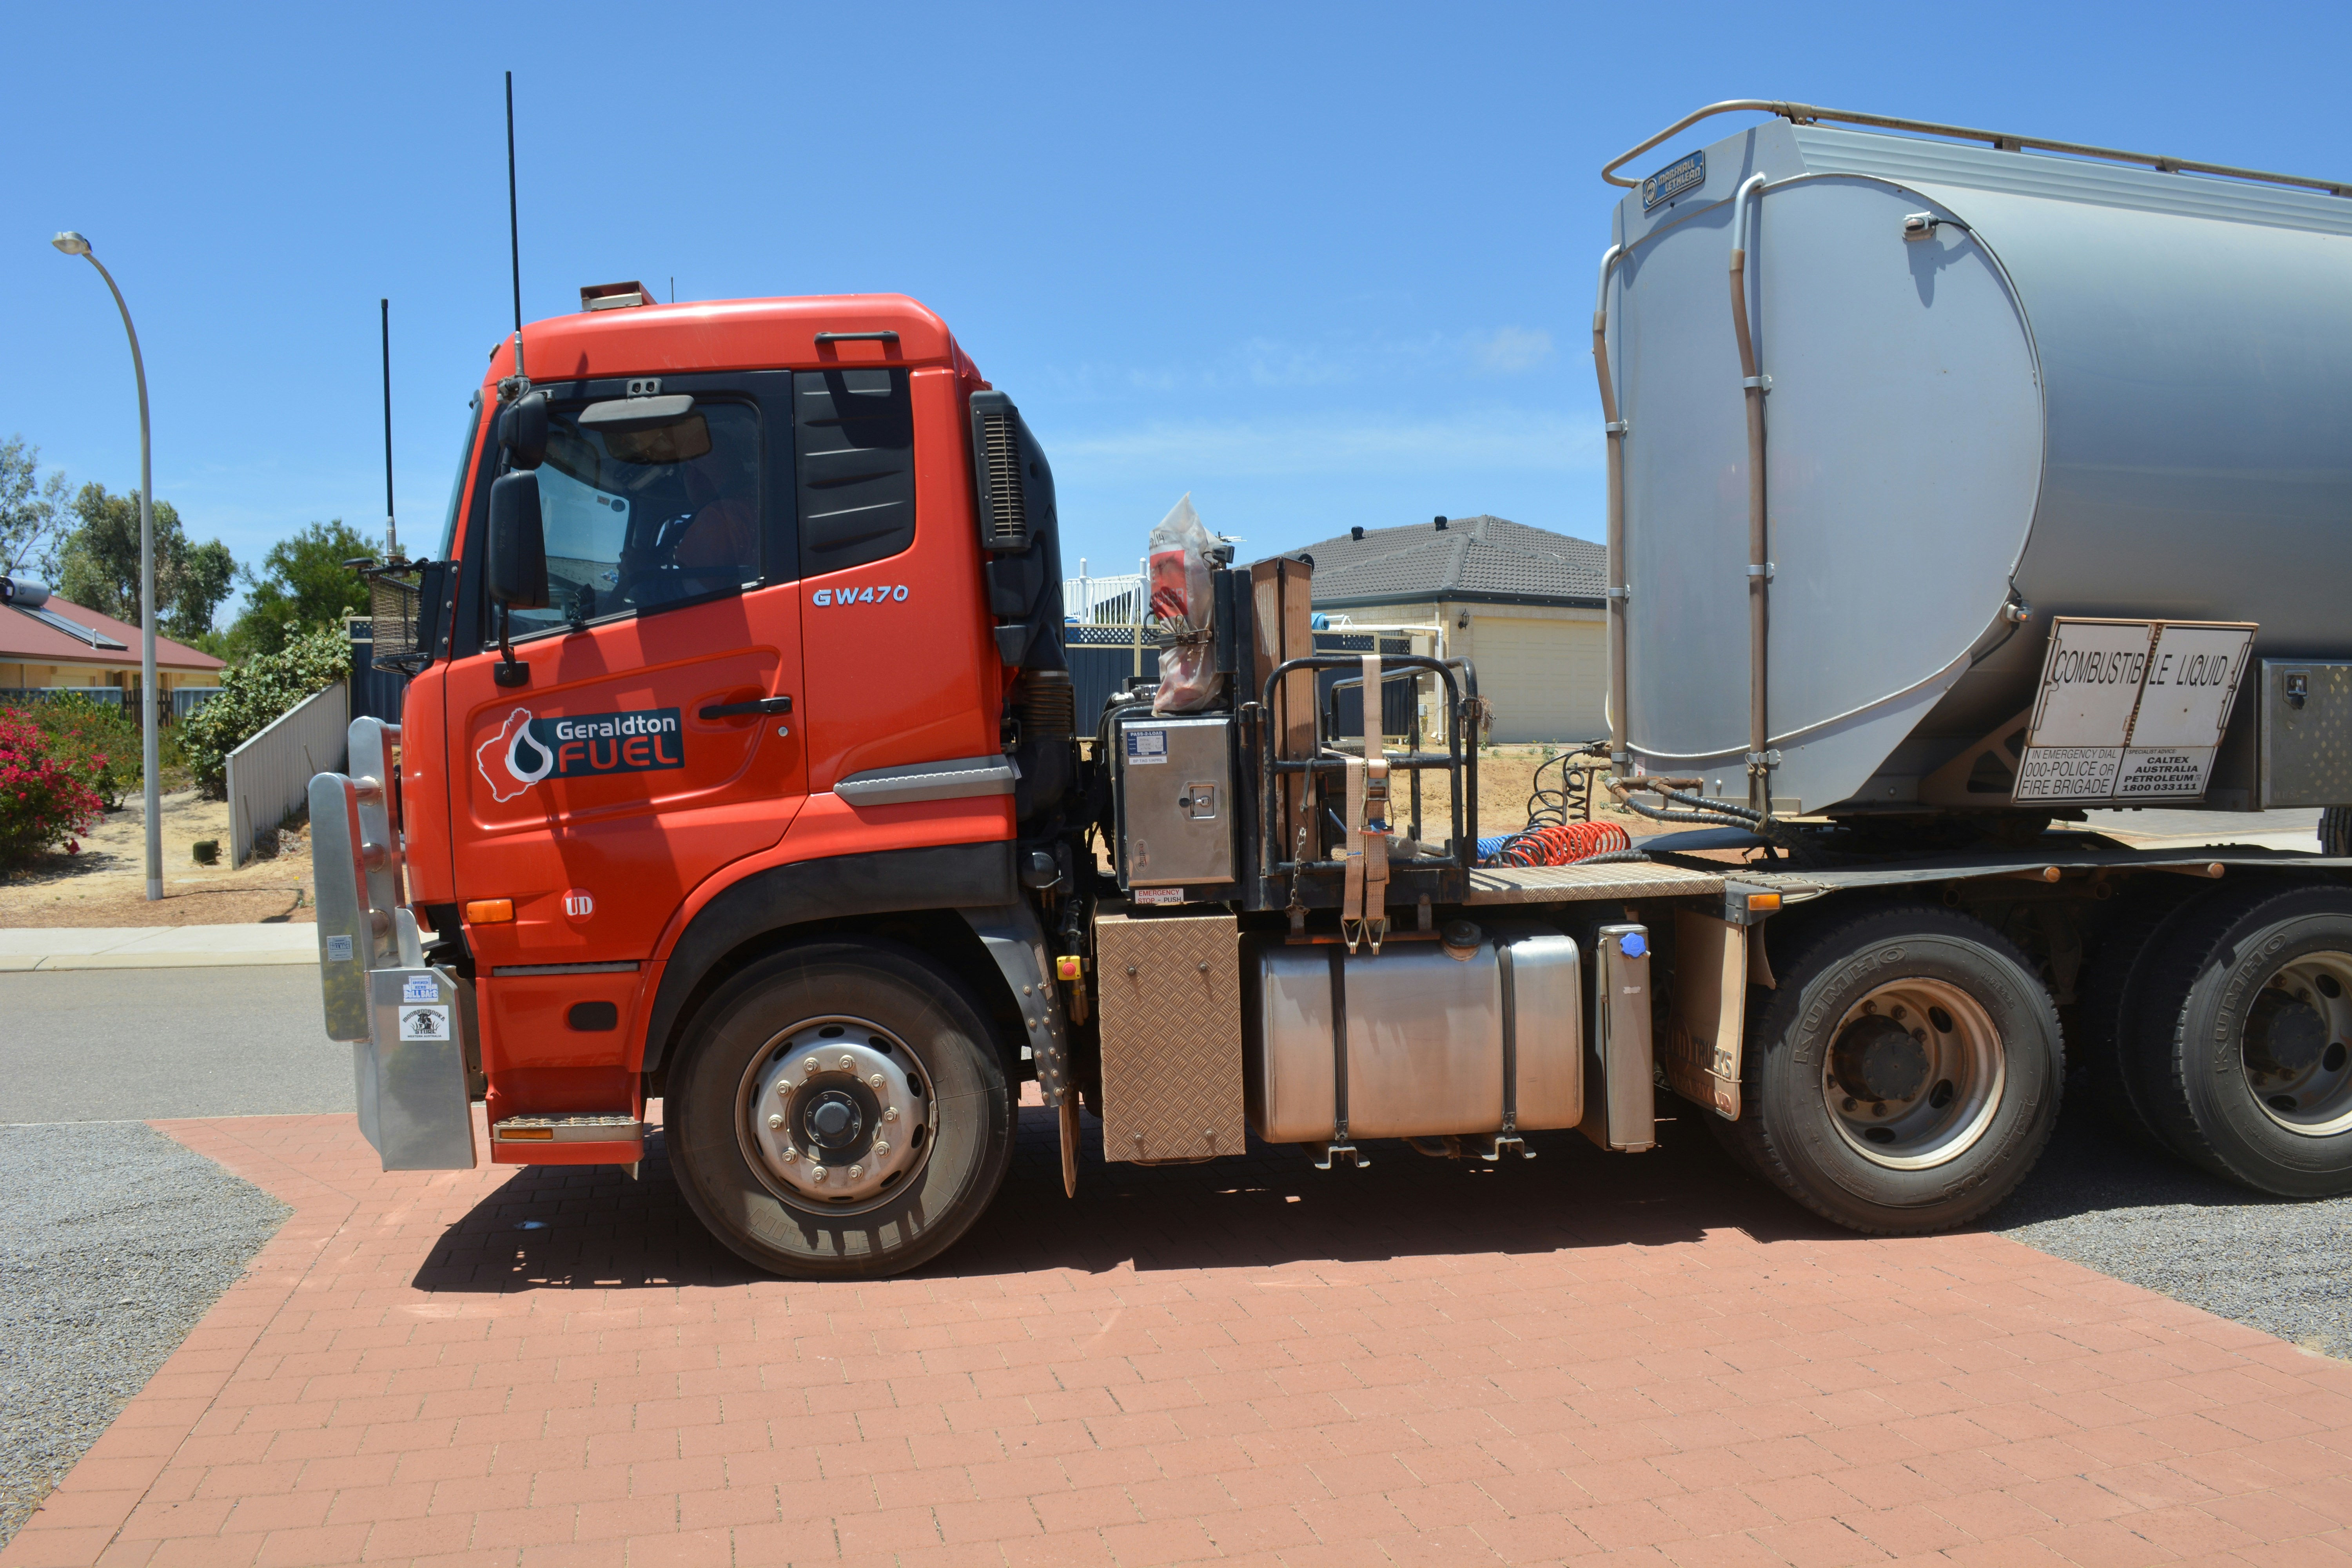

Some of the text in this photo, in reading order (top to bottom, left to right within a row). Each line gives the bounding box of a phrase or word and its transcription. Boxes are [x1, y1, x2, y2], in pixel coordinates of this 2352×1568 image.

[1659, 158, 1695, 185] MARSHALL
[1665, 167, 1701, 192] LETHLEAN
[813, 585, 909, 606] GW470
[2176, 654, 2228, 686] LIQUID
[556, 715, 676, 740] Geraldton
[558, 735, 678, 773] FUEL
[2032, 750, 2116, 759] IN EMERGENCY DIAL
[2025, 761, 2114, 777] 000-POLICE OR
[2021, 779, 2110, 795] FIRE BRIGADE
[565, 897, 593, 916] UD
[404, 989, 421, 998] BULL
[1794, 946, 1906, 1064] KUMHO
[2214, 933, 2287, 1074] KUMHO
[1692, 1036, 1732, 1078] TRUCKS
